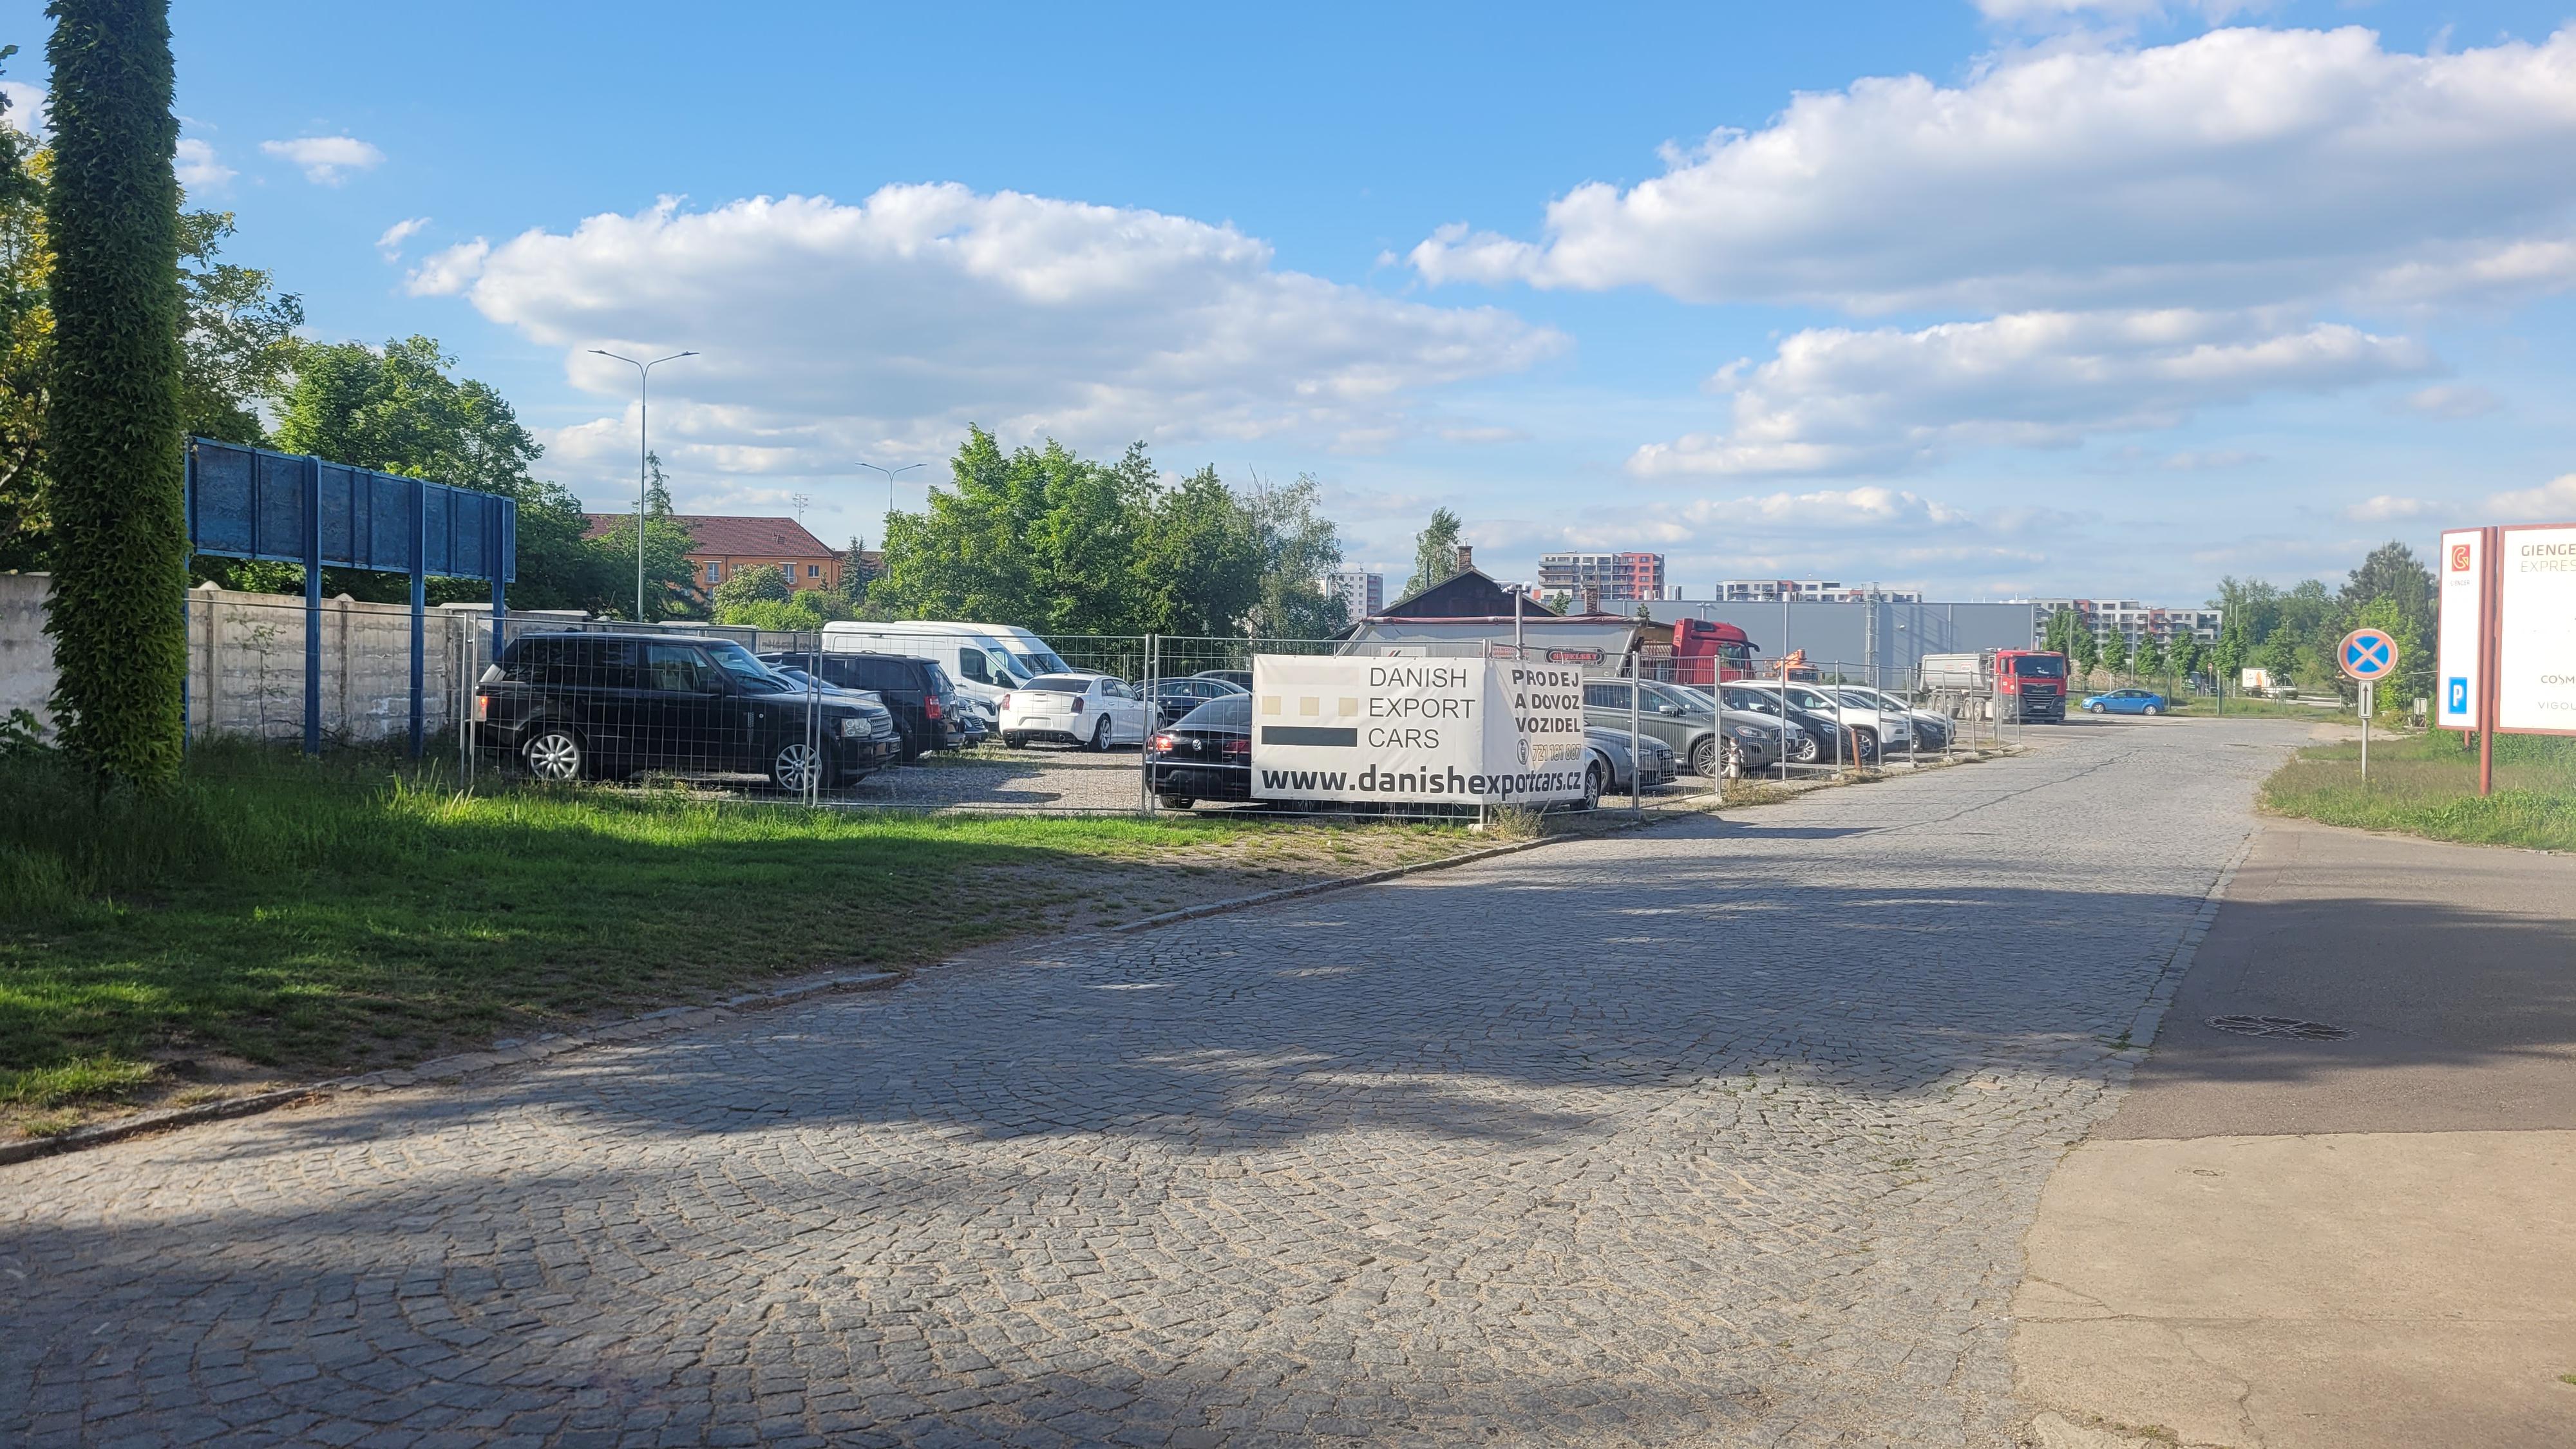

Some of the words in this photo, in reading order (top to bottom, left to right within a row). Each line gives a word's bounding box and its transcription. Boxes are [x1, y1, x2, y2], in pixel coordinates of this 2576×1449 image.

[2521, 544, 2576, 556] GIENGE
[2521, 560, 2576, 573] EXPRES
[1370, 667, 1466, 688] DANISH
[1511, 669, 1579, 687] PRODEJ
[1369, 697, 1476, 719] EXPORT
[1514, 693, 1527, 709] A
[1531, 694, 1580, 710] DOVOZ
[1515, 717, 1580, 734] VOZIDEL
[1368, 728, 1439, 749] CARS
[1532, 744, 1548, 762] 721
[1549, 744, 1564, 761] 181
[1565, 743, 1582, 761] 887
[1262, 764, 1581, 801] www.danishexportcars.cz
